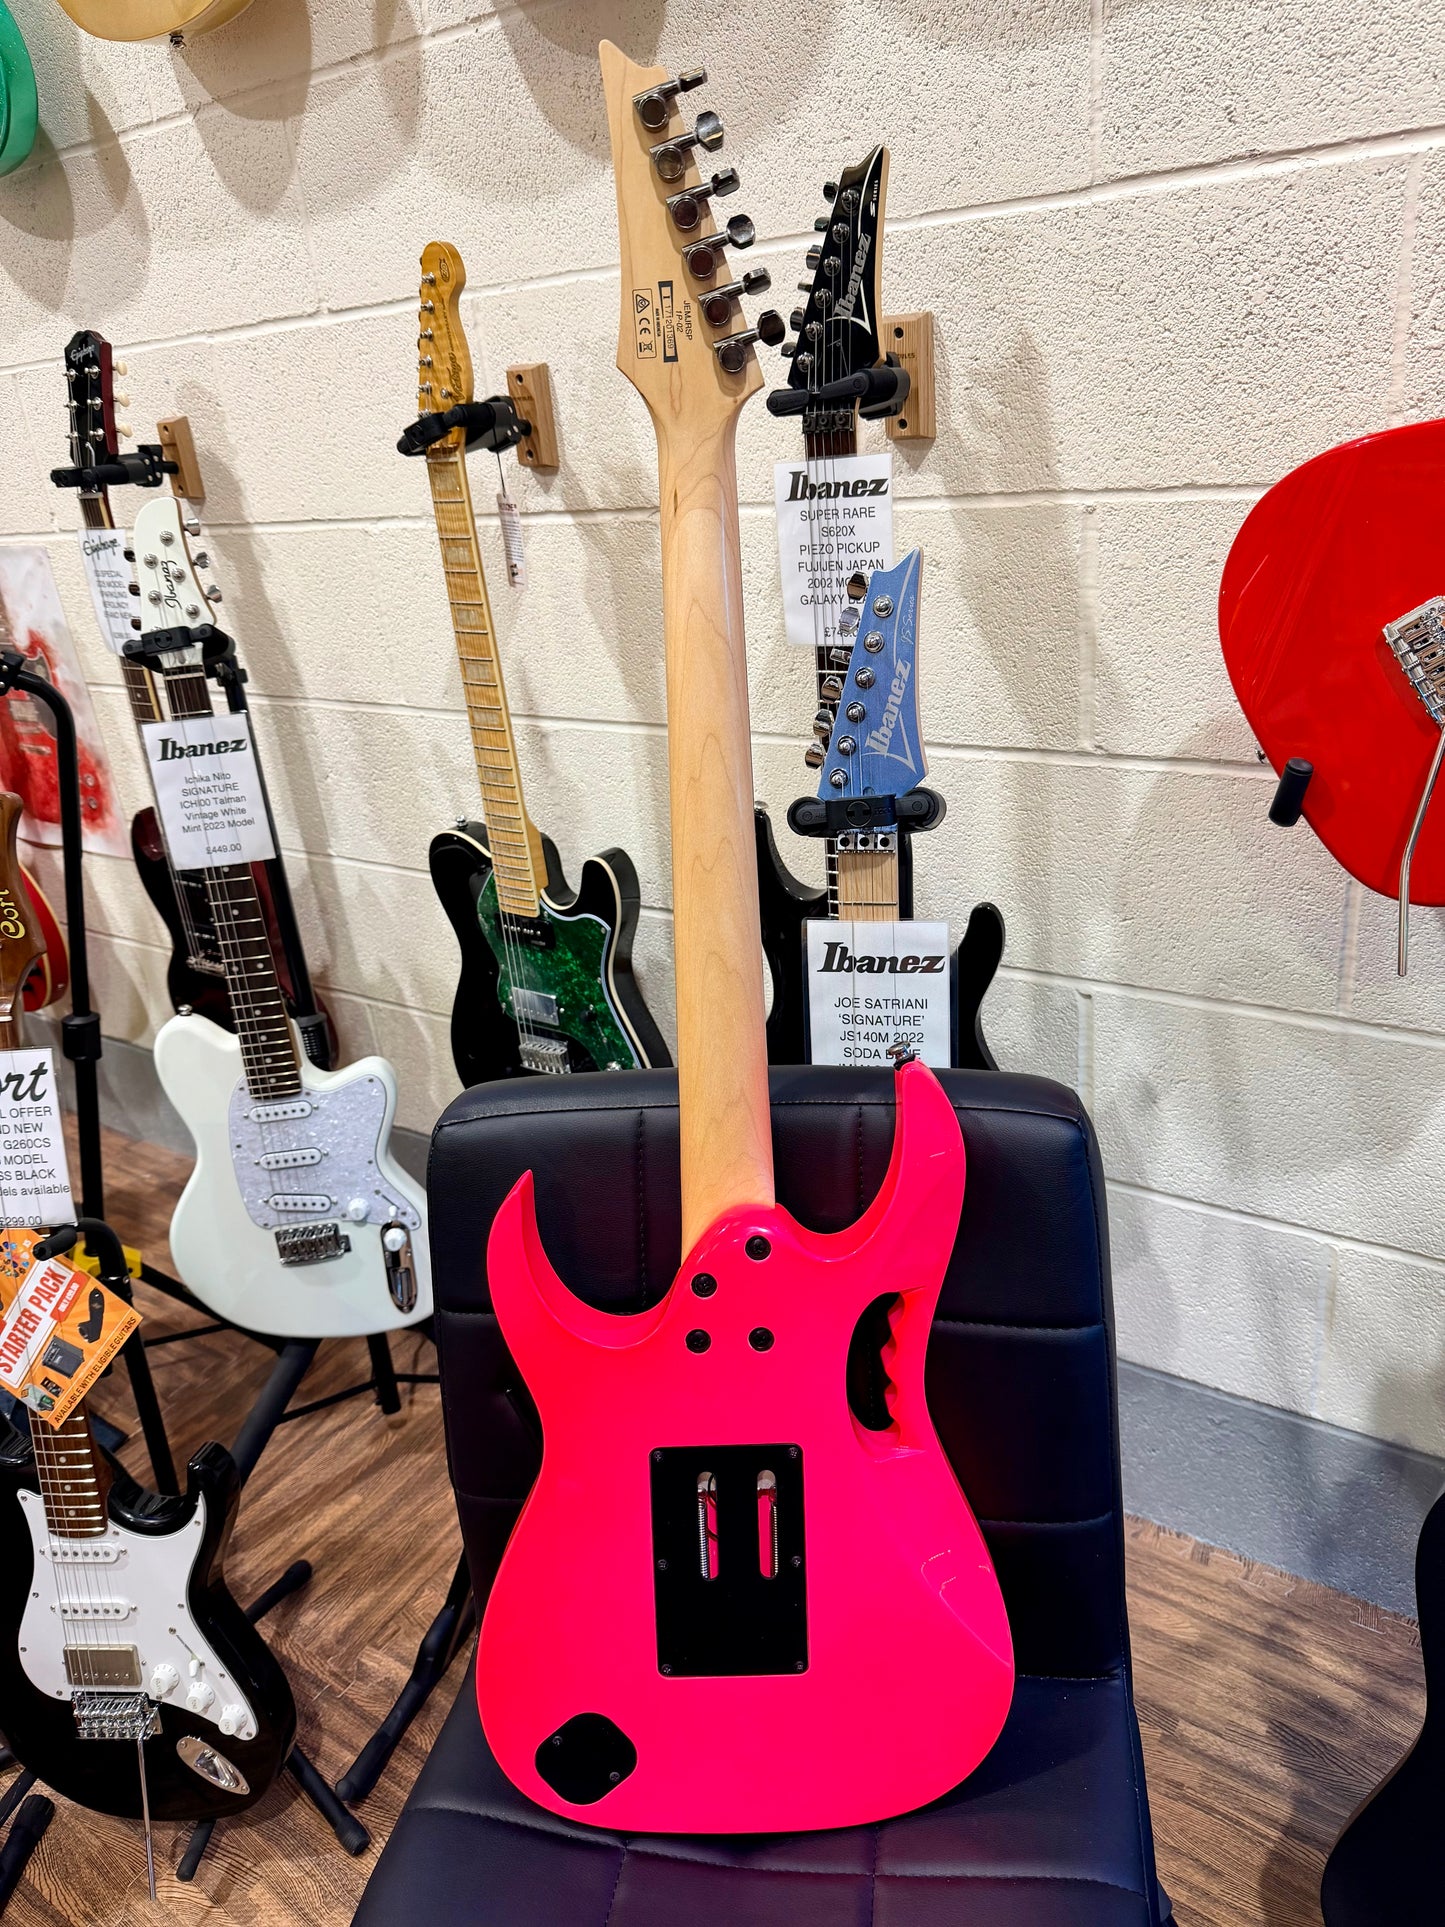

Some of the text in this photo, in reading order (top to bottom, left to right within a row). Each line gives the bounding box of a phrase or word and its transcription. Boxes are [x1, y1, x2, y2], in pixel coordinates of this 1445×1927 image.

[833, 232, 872, 320] Ibanez
[785, 470, 890, 502] Ibanez
[800, 506, 876, 521] SUPER RARE
[821, 525, 856, 537] S620X
[800, 541, 880, 555] PIEZO PICKUP
[846, 559, 884, 570] JAPAN
[161, 560, 182, 610] Ibanez
[807, 578, 833, 588] 2002
[800, 594, 845, 605] GALAXY
[865, 658, 912, 759] Ibanez
[157, 737, 248, 761] Ibanez
[212, 772, 231, 781] Nito
[181, 782, 240, 797] SIGNATURE
[212, 795, 247, 806] Talman
[184, 807, 247, 821] Vintage White
[182, 817, 255, 833] Mint 2023 Model
[205, 842, 242, 855] £449.00
[817, 941, 946, 974] Ibanez
[834, 997, 928, 1010] JOE SATRIANI
[840, 1030, 925, 1043] JS140M 2022
[843, 1047, 882, 1060] SODA
[9, 1106, 52, 1119] OFFER
[14, 1122, 43, 1134] NEW
[3, 1138, 51, 1150] G260CS
[4, 1154, 48, 1165] MODEL
[15, 1169, 56, 1181] BLACK
[20, 1183, 70, 1196] available
[0, 1266, 66, 1375] STARTER PACK
[54, 1316, 137, 1423] AVAILABLE WITH ELIGIBLE GUITARS
